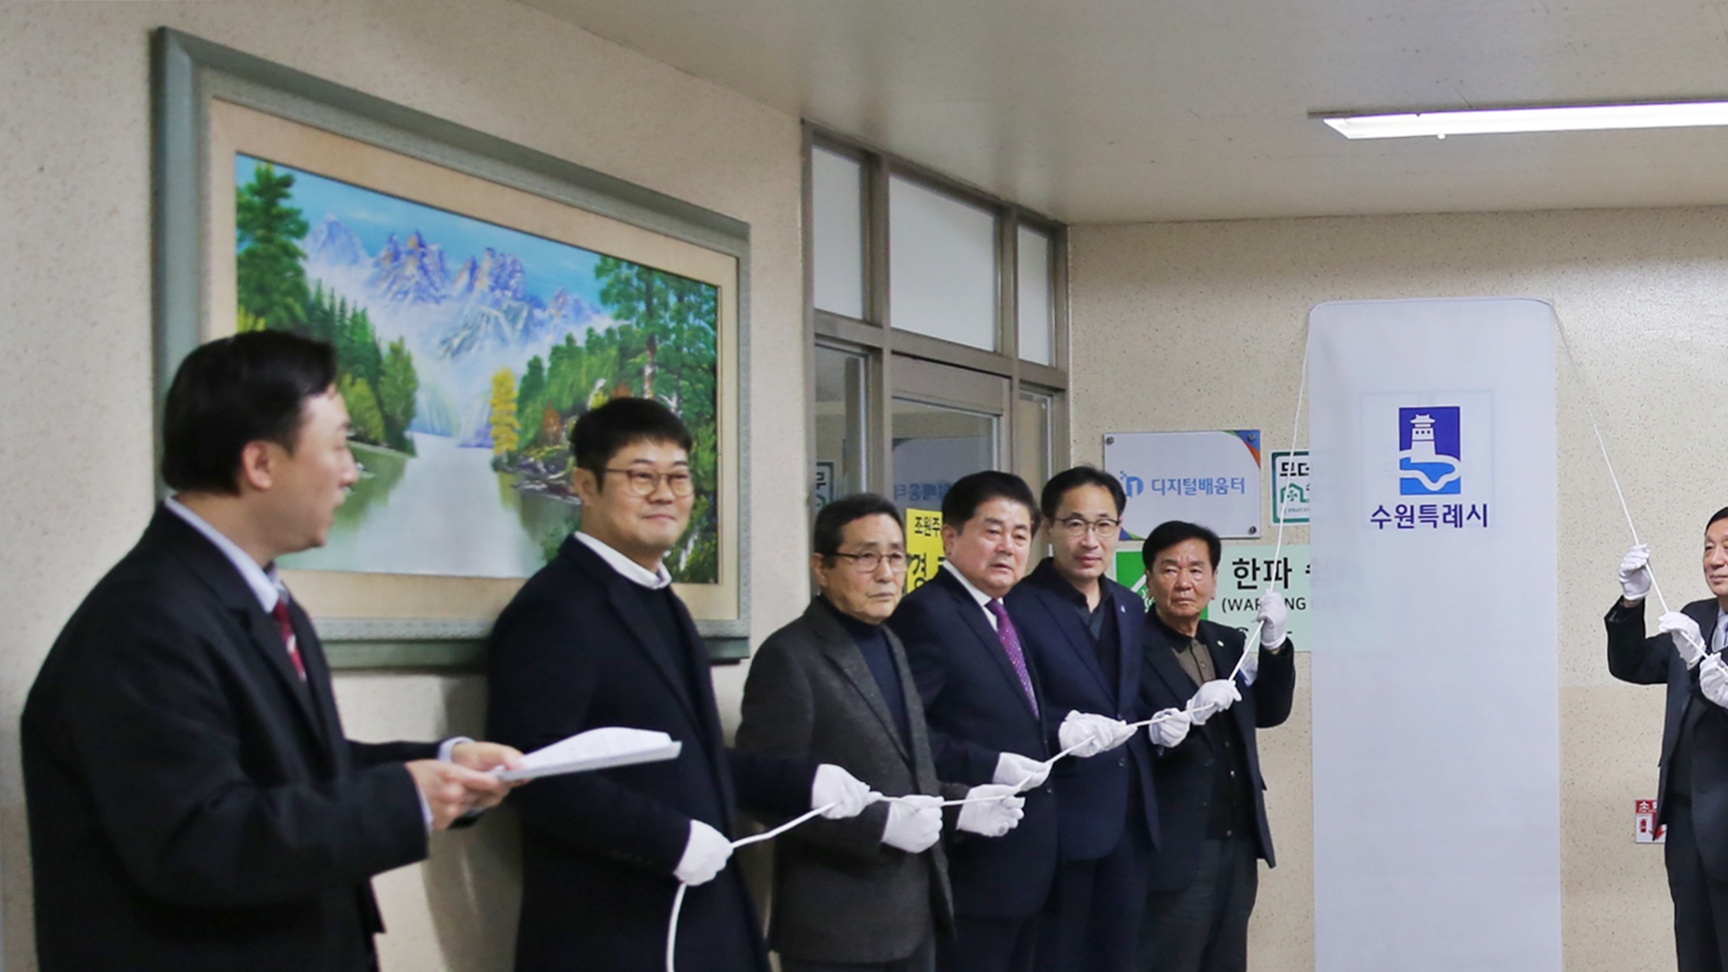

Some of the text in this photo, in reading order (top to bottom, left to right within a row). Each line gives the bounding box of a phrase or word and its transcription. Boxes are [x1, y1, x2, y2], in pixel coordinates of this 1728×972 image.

[1152, 477, 1245, 496] 디지털배움터
[1370, 503, 1488, 529] 수원특례시
[1232, 557, 1292, 590] 한파
